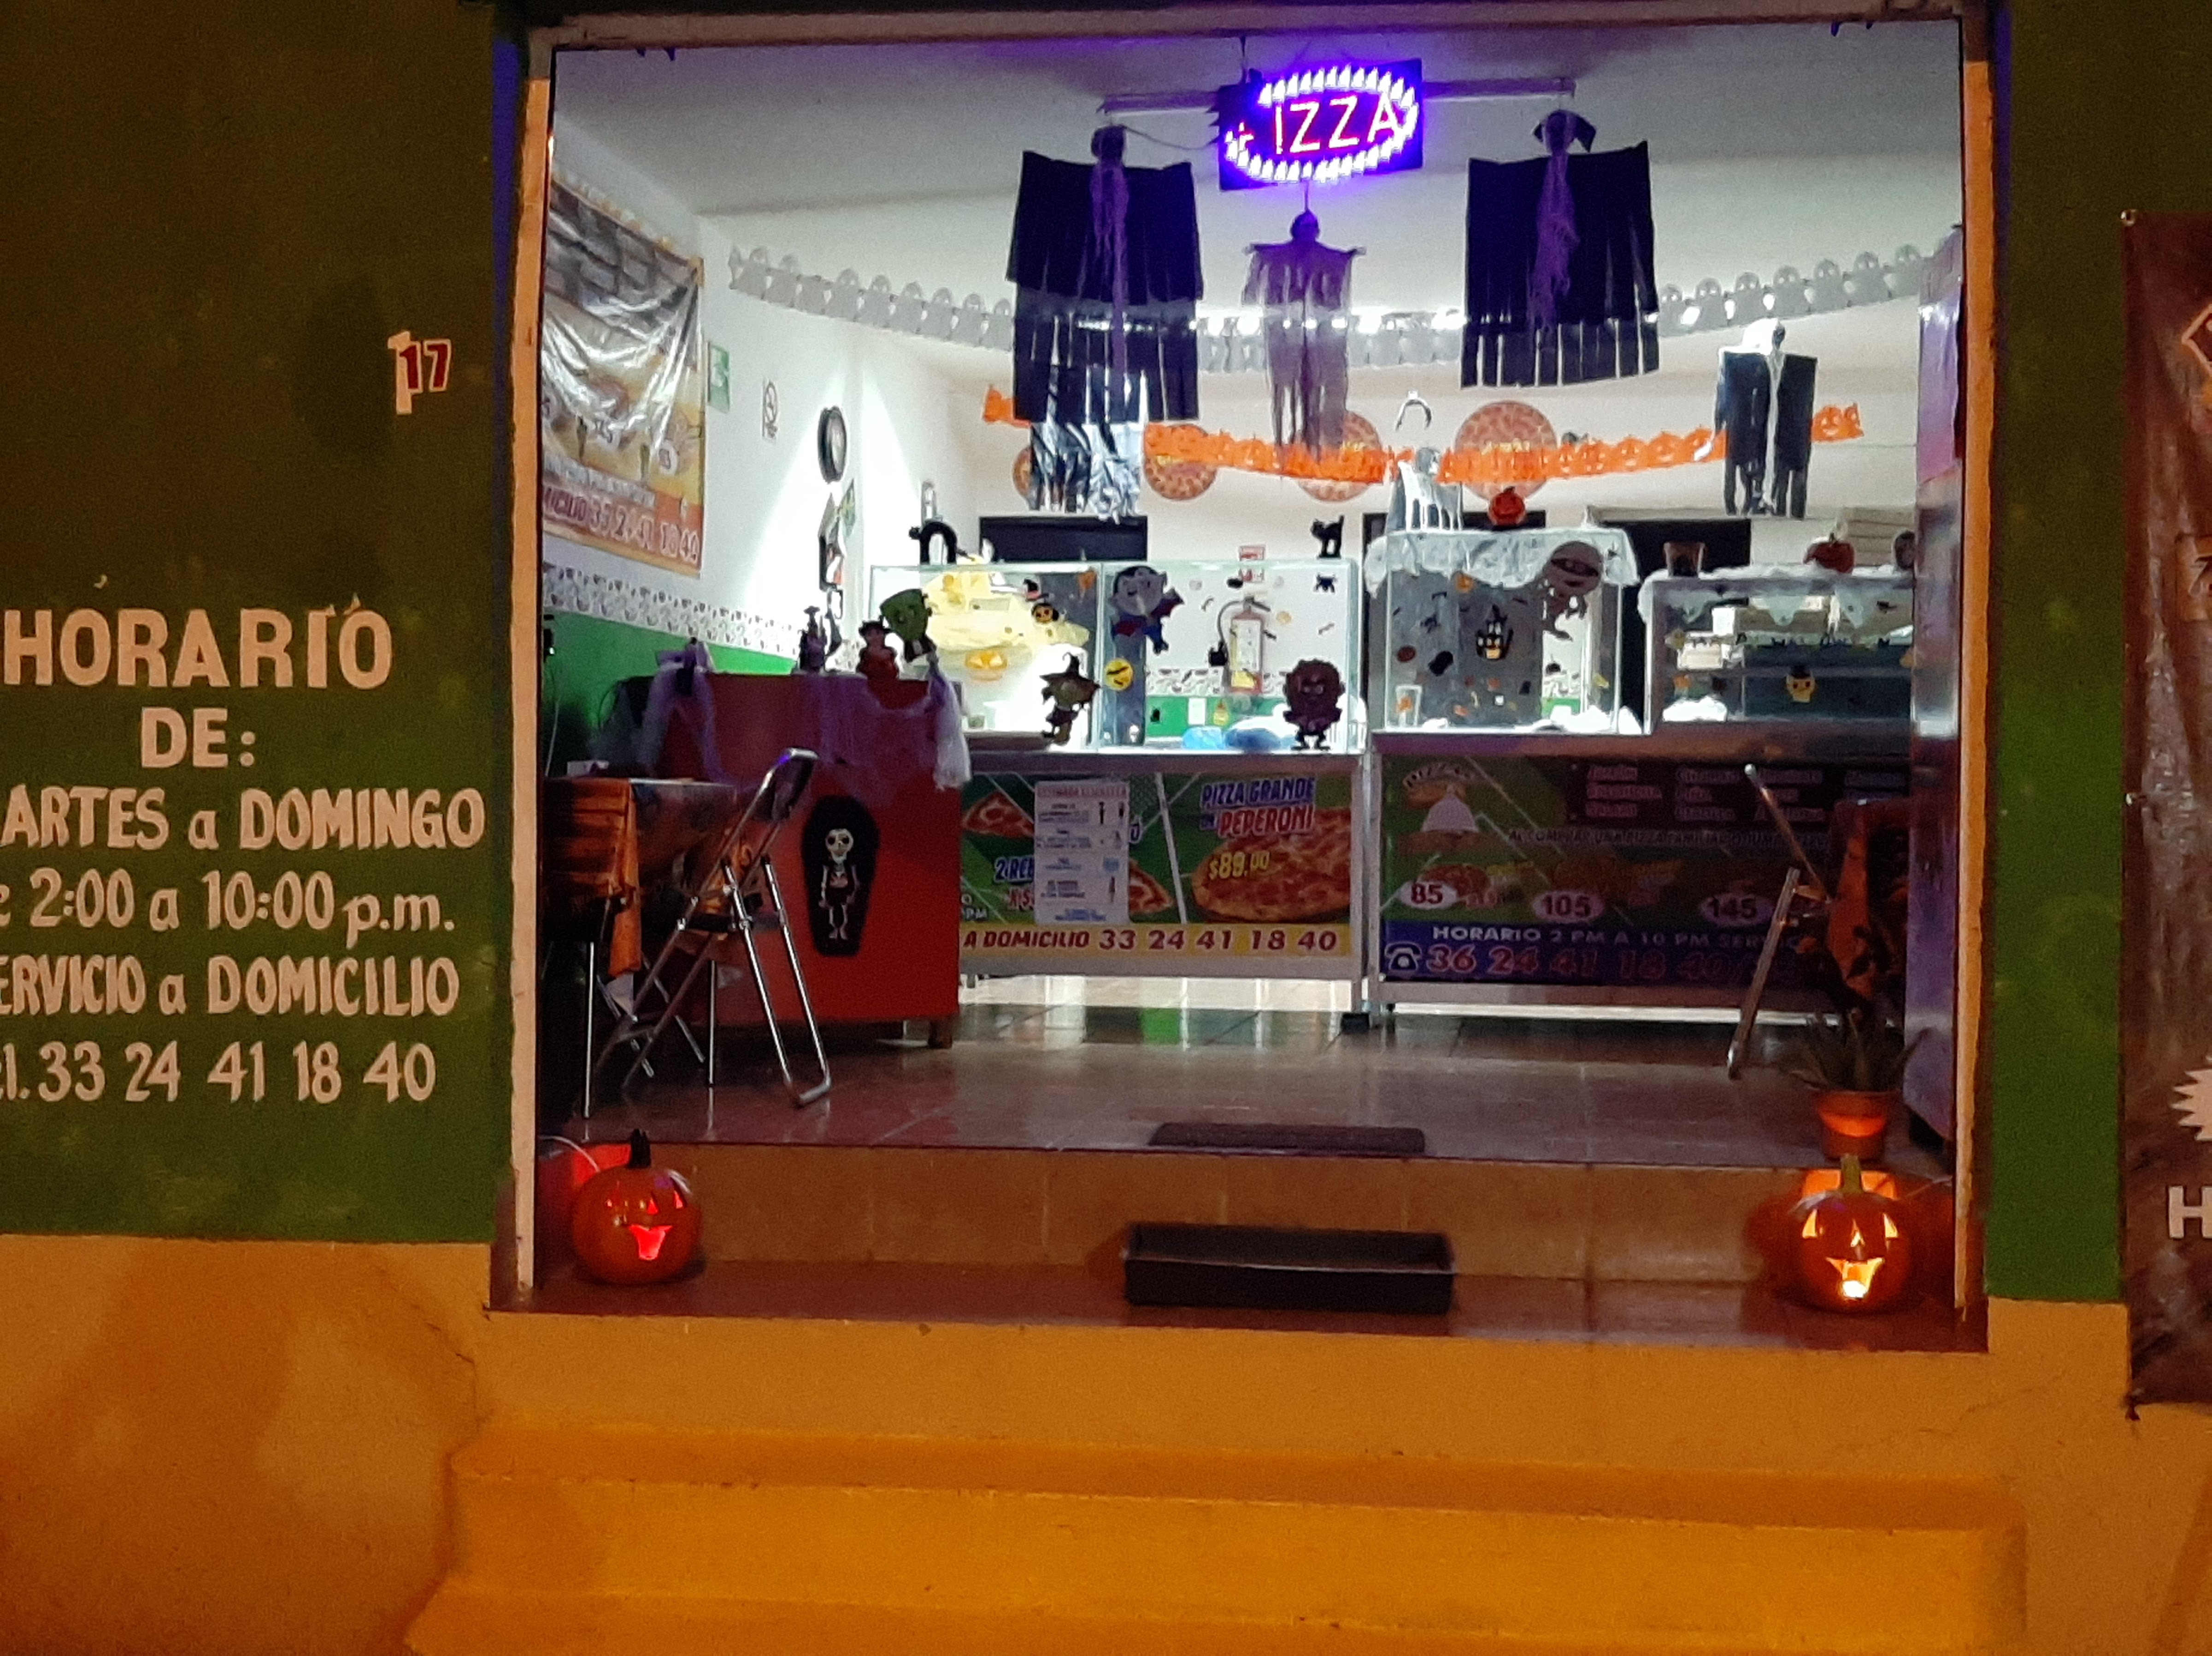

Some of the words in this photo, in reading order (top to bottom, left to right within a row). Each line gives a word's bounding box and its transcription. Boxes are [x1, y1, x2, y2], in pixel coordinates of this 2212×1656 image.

[4, 607, 393, 689] HORARIO
[141, 707, 255, 768] DE:
[1201, 782, 1245, 806] PIZZA
[1247, 778, 1315, 804] GRANDE
[188, 810, 219, 849] a
[239, 788, 485, 850] DOMINGO
[1218, 805, 1314, 837] PEPERONI
[30, 867, 134, 927] 2:00
[149, 889, 179, 931] a
[202, 870, 335, 930] 10:00
[342, 894, 455, 949] p.m.
[1411, 883, 1444, 904] 85
[1542, 894, 1592, 917] 105
[983, 931, 1090, 948] DOMICILIO
[1099, 929, 1136, 949] 33
[1148, 930, 1184, 950] 24
[1196, 930, 1231, 949] 41
[1253, 930, 1286, 950] 18
[1298, 931, 1336, 951] 40
[1432, 926, 1541, 942] HORARIO
[159, 974, 187, 1015] a
[208, 955, 459, 1017] DOMICILIO
[39, 1041, 105, 1102] 33
[125, 1040, 181, 1102] 24
[207, 1041, 265, 1102] 41
[293, 1041, 341, 1103] 18
[363, 1041, 435, 1102] 40
